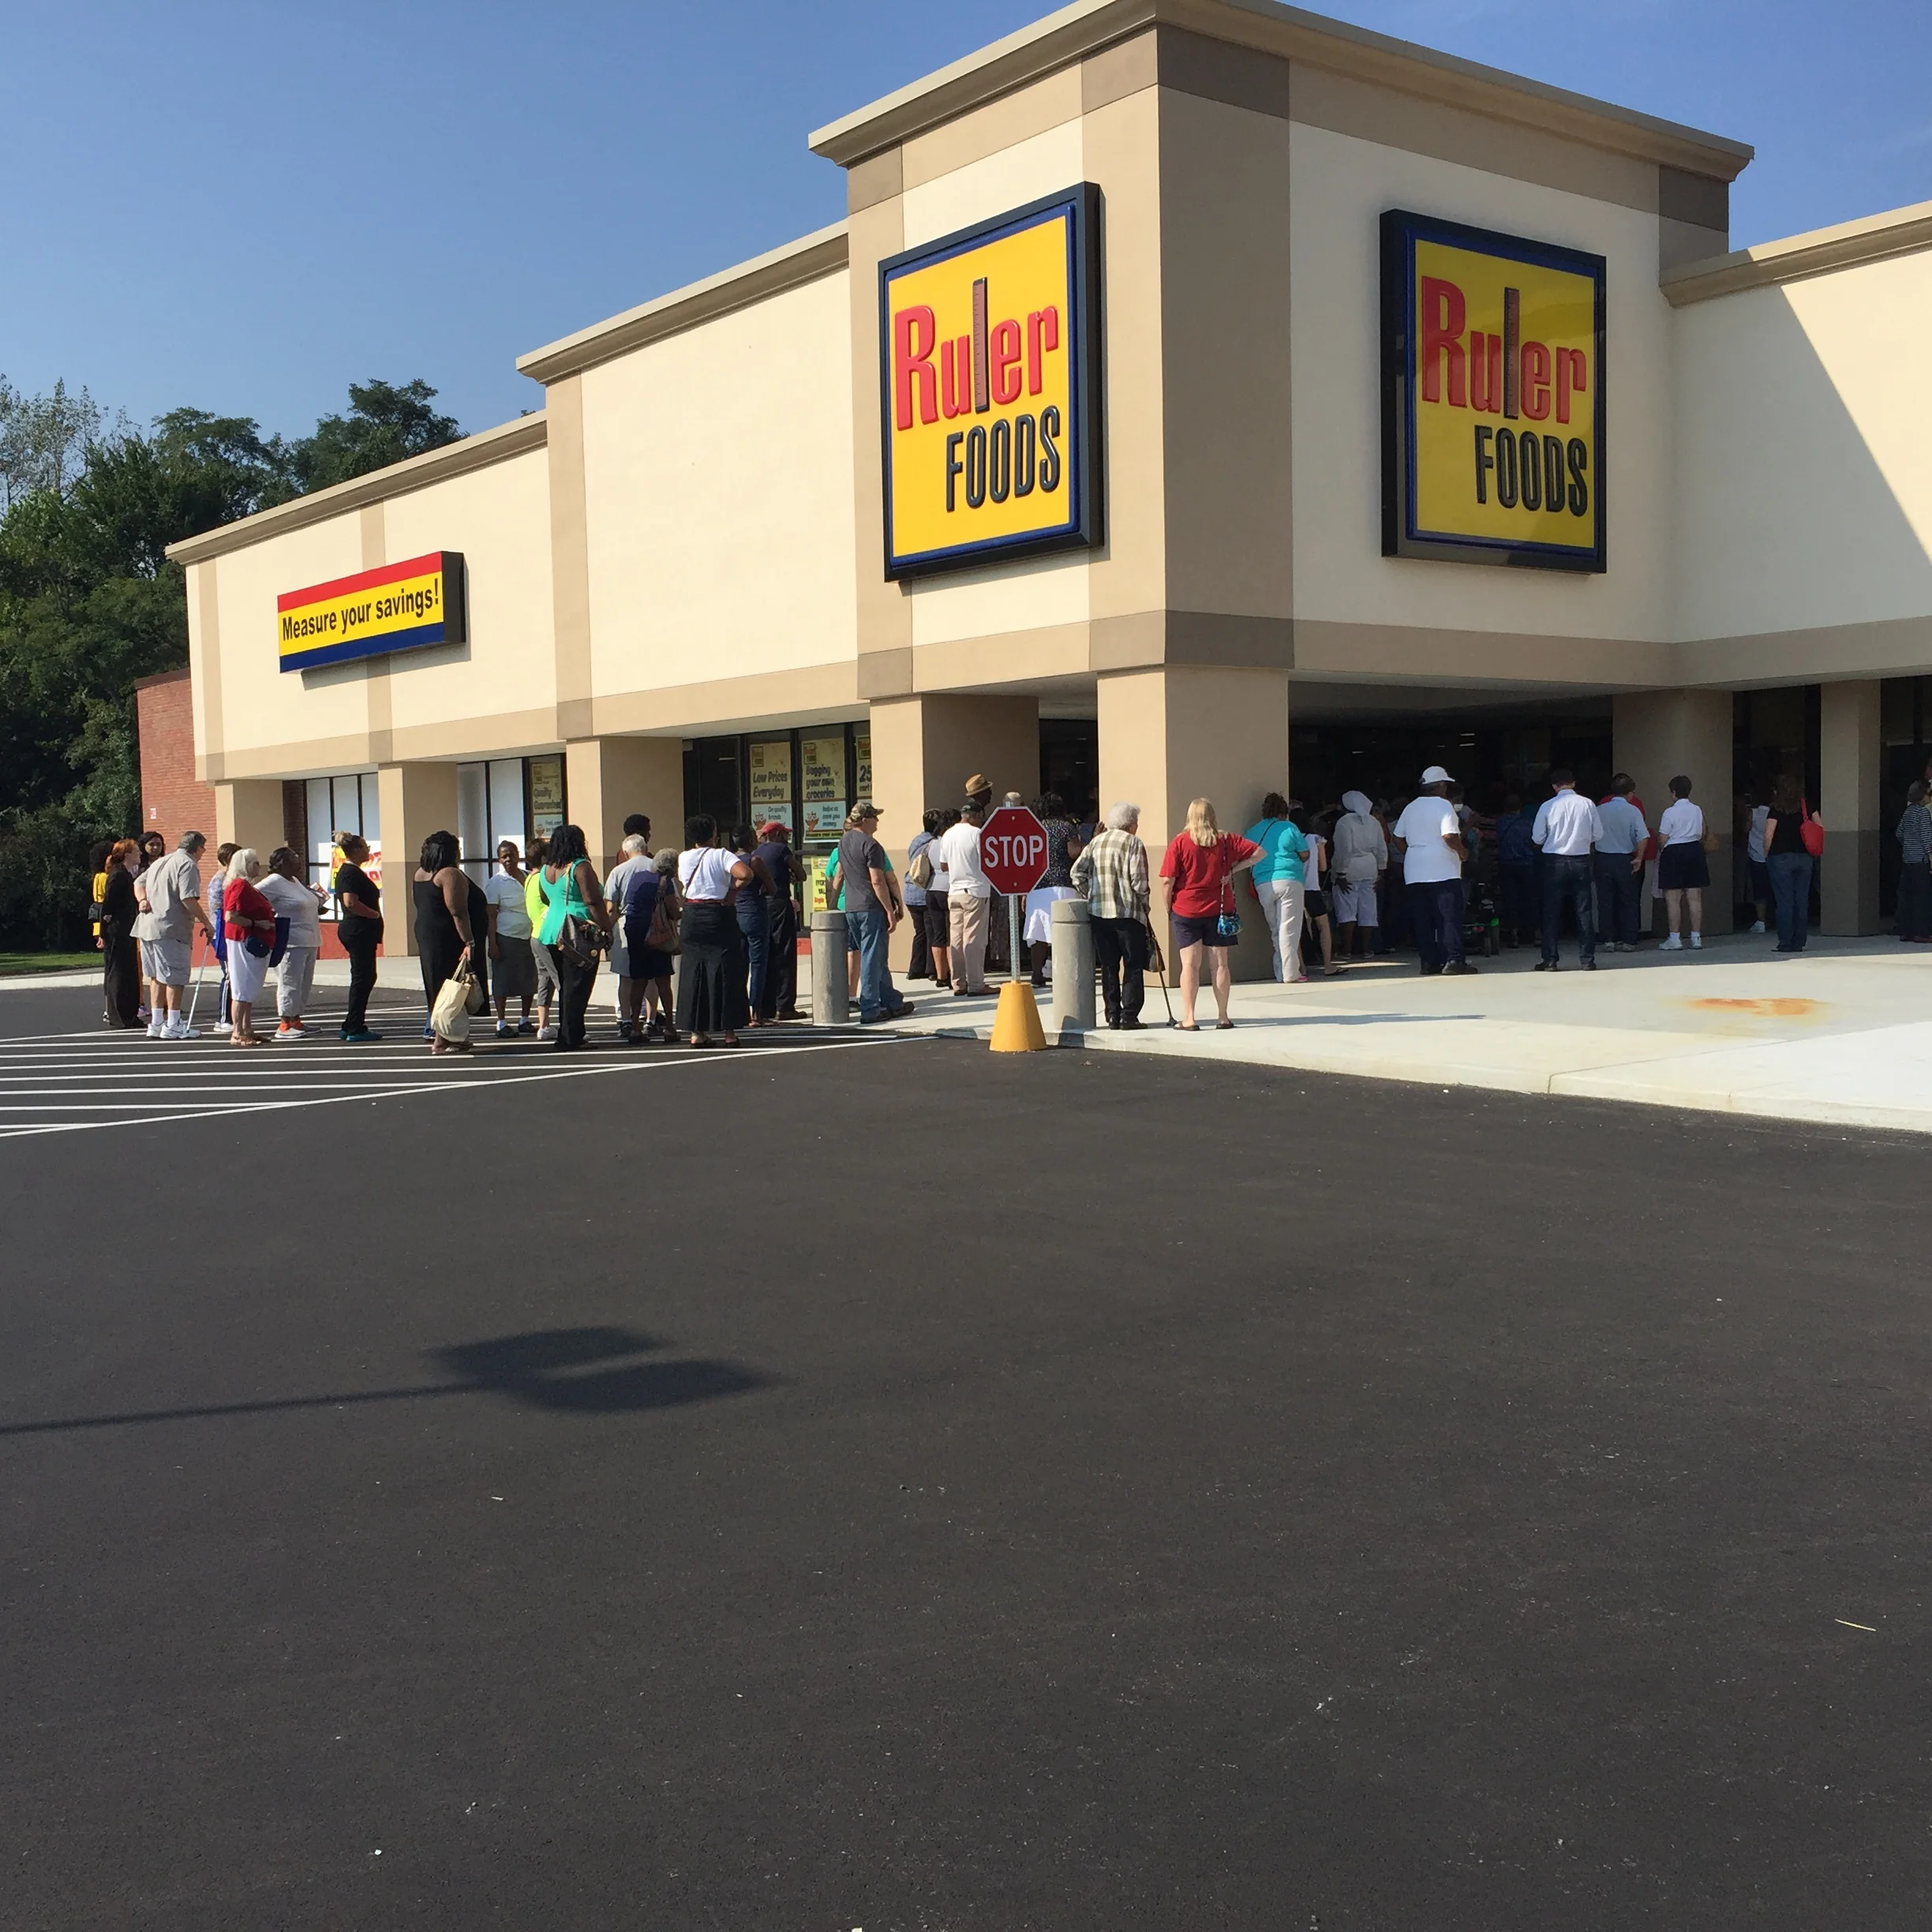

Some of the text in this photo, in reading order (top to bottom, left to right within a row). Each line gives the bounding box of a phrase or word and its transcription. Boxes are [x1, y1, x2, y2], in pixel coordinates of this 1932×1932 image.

[894, 276, 1059, 431] Ruler
[1421, 275, 1587, 424] Ruler
[946, 405, 1061, 512] FOODS
[1474, 425, 1589, 517] FOODS
[283, 578, 439, 641] Measure your savings!
[753, 769, 788, 783] Low Prices
[753, 785, 784, 799] Everyday
[806, 788, 835, 799] groceries
[984, 835, 1043, 867] STOP
